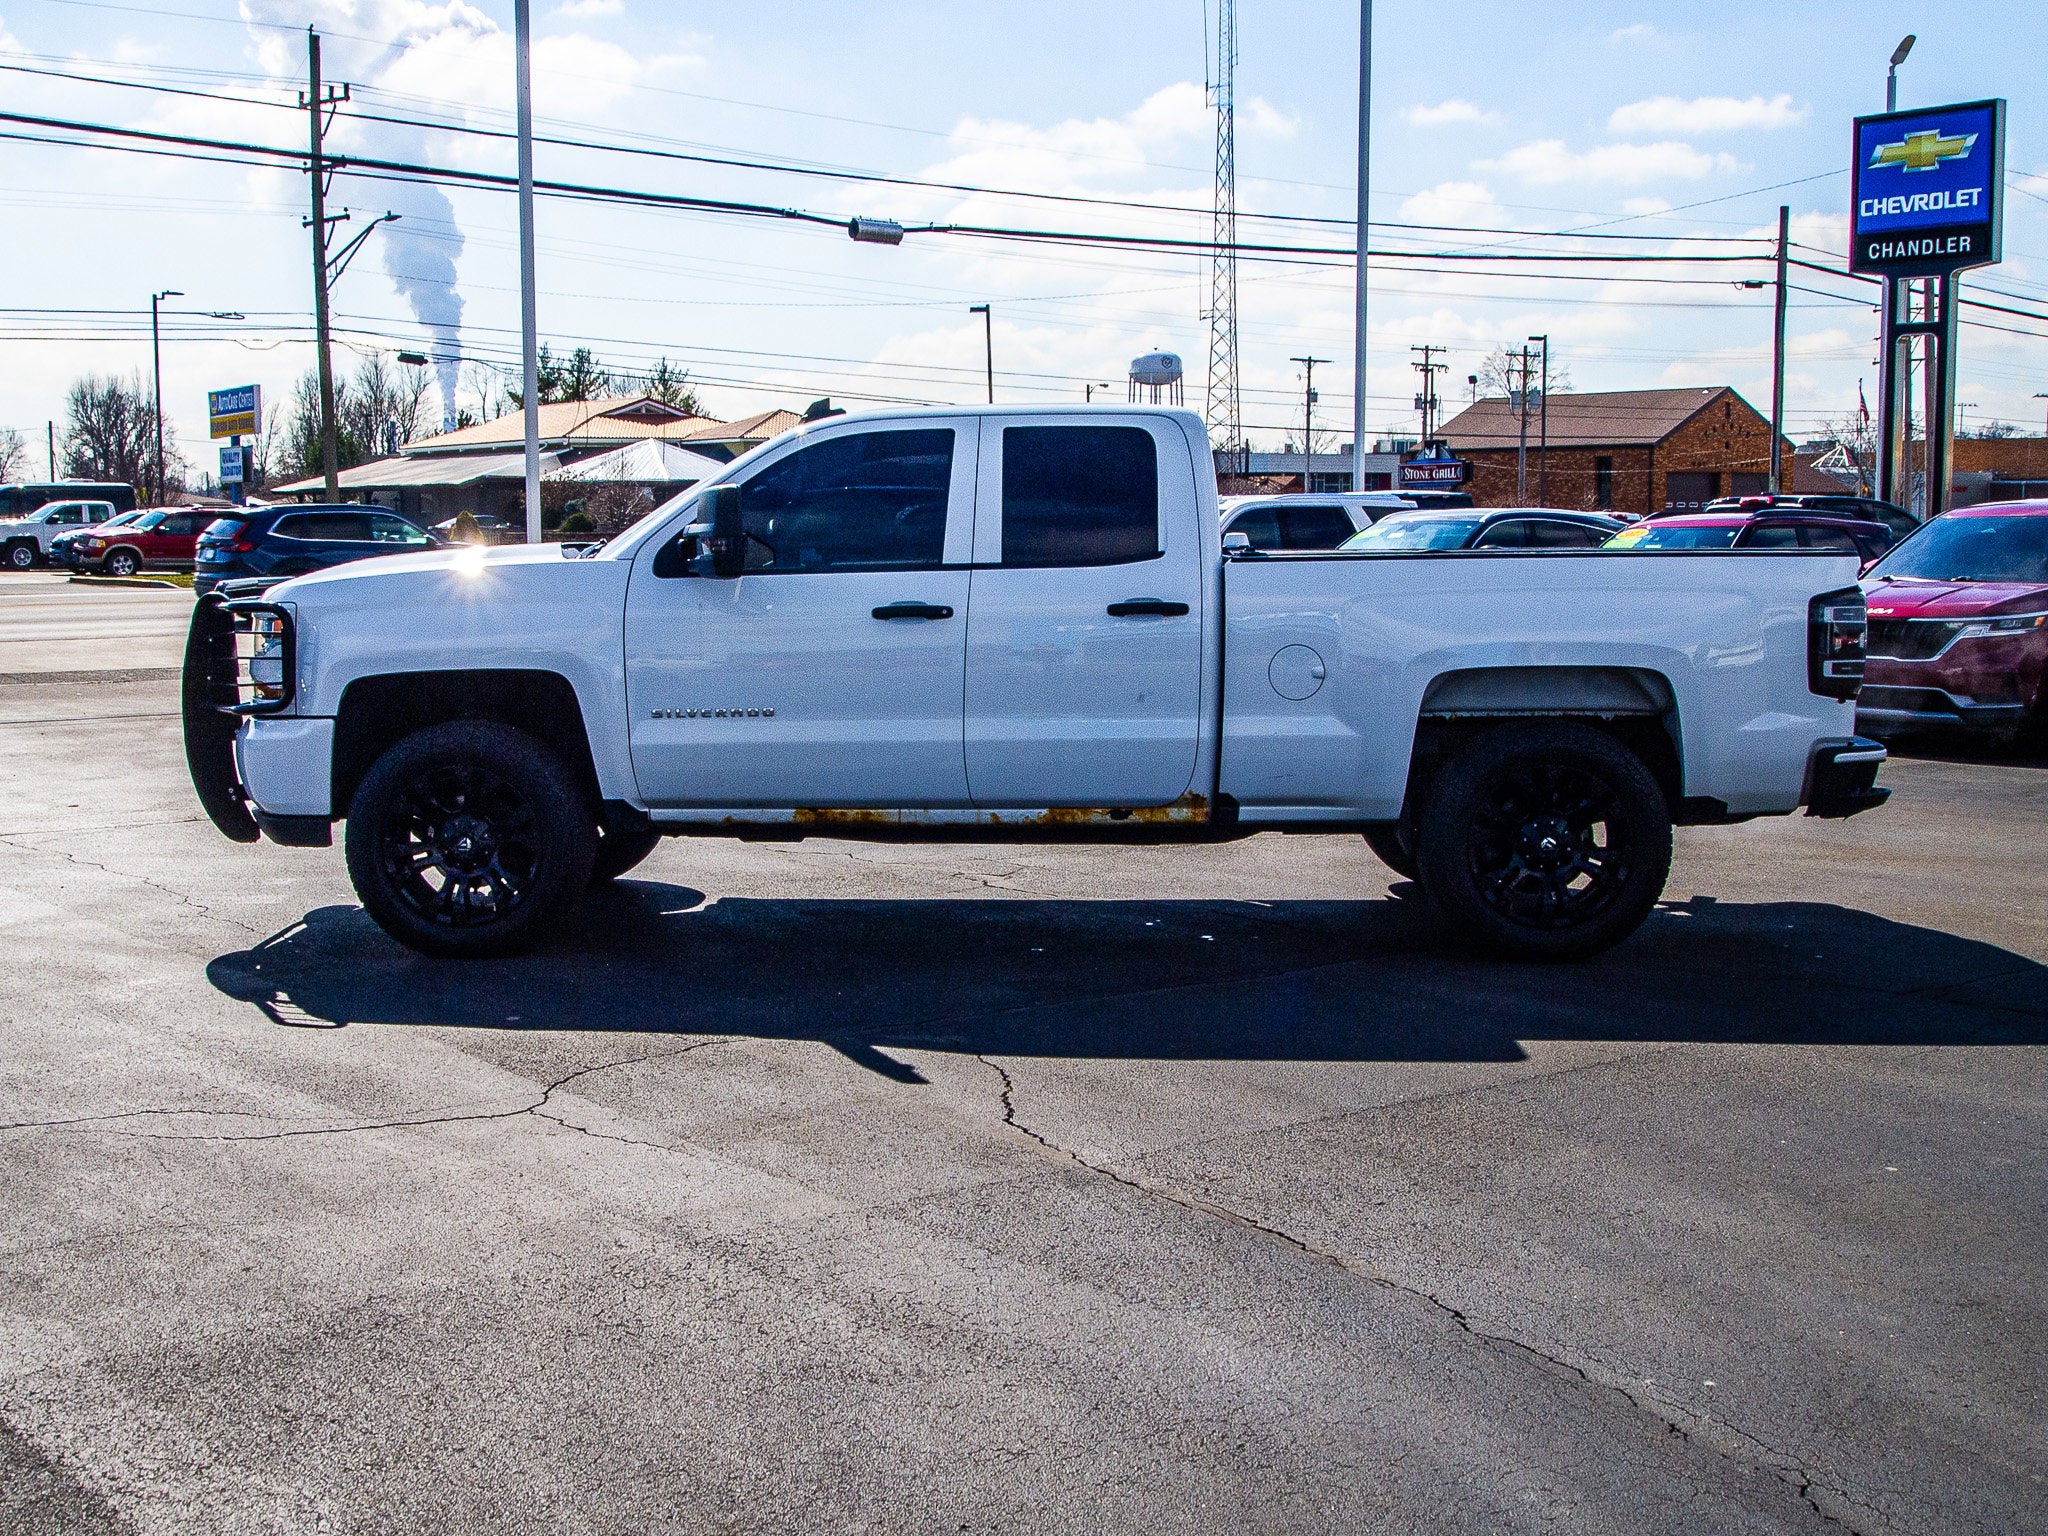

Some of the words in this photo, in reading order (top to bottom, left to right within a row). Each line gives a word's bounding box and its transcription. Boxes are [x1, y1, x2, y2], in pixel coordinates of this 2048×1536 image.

[1861, 188, 1982, 217] CHEVROLET
[1869, 236, 1971, 260] CHANDLER
[1404, 468, 1430, 480] STONE
[1433, 467, 1456, 479] GRILL
[651, 707, 775, 719] SILVERADO
